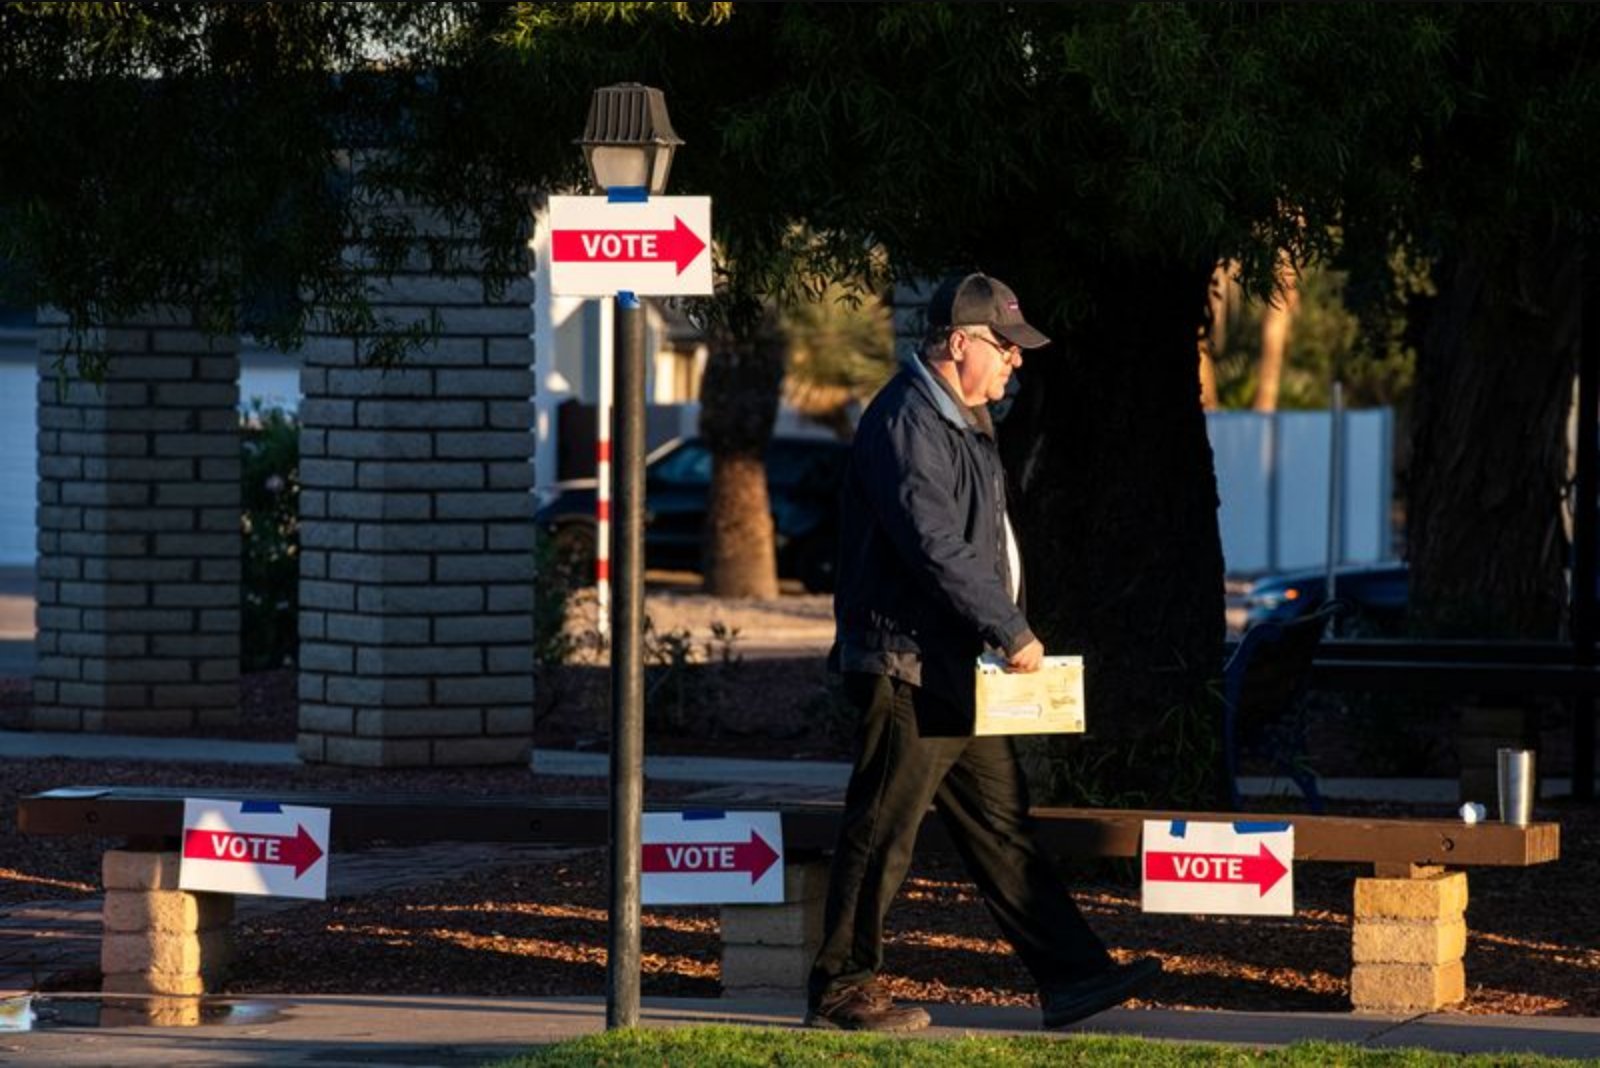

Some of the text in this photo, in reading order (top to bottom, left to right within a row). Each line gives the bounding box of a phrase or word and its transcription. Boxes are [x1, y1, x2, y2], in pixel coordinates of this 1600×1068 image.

[581, 234, 658, 258] VOTE
[211, 834, 281, 860] VOTE
[666, 847, 735, 868] VOTE
[1172, 856, 1243, 879] VOTE
